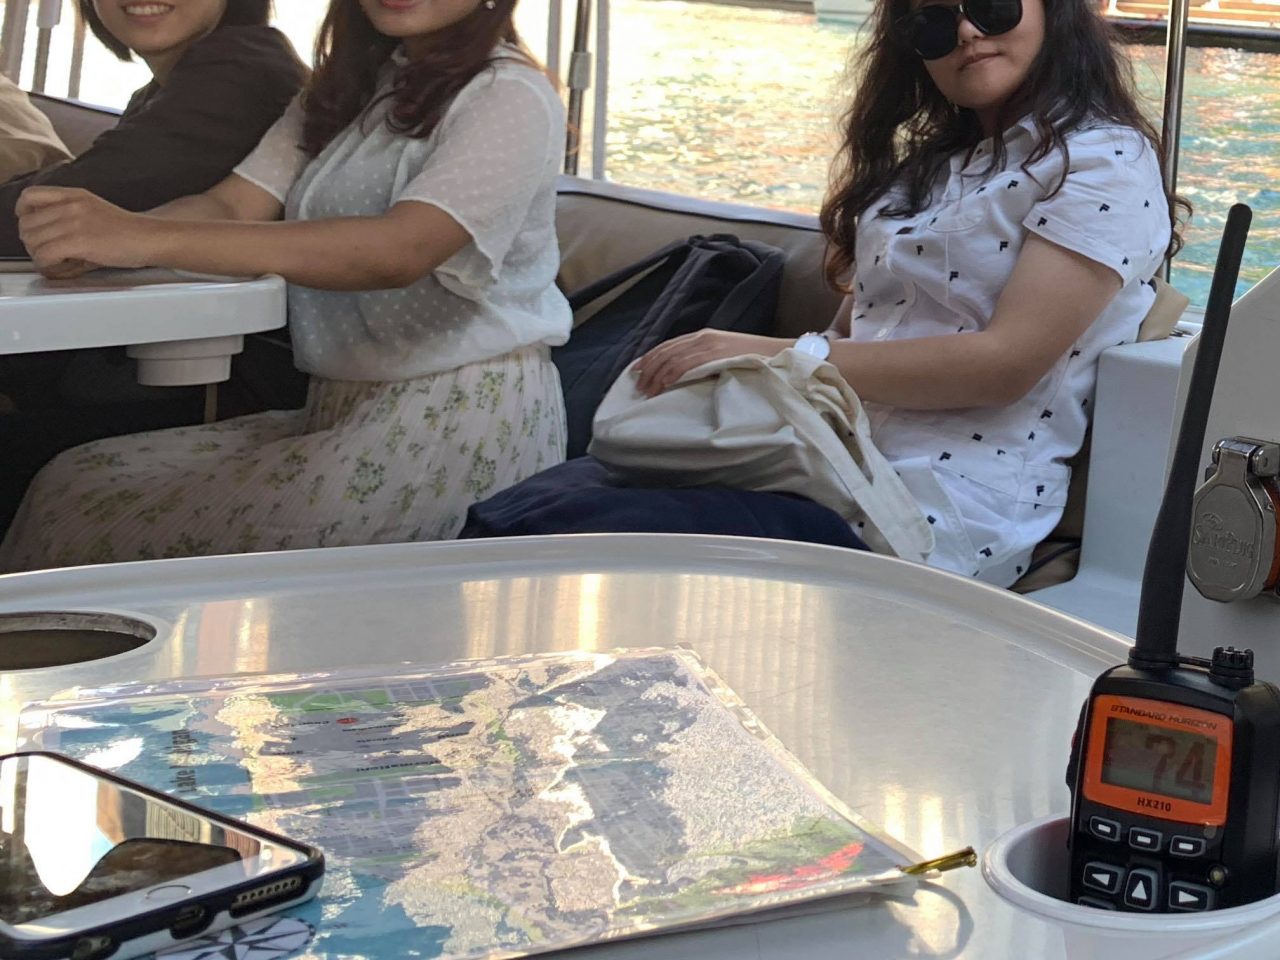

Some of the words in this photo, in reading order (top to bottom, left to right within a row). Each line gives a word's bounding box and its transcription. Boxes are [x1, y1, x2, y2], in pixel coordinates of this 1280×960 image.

[1110, 704, 1166, 721] STANDARD
[1168, 714, 1217, 730] HORIZON
[1144, 733, 1206, 790] 74
[1136, 796, 1172, 812] HX210
